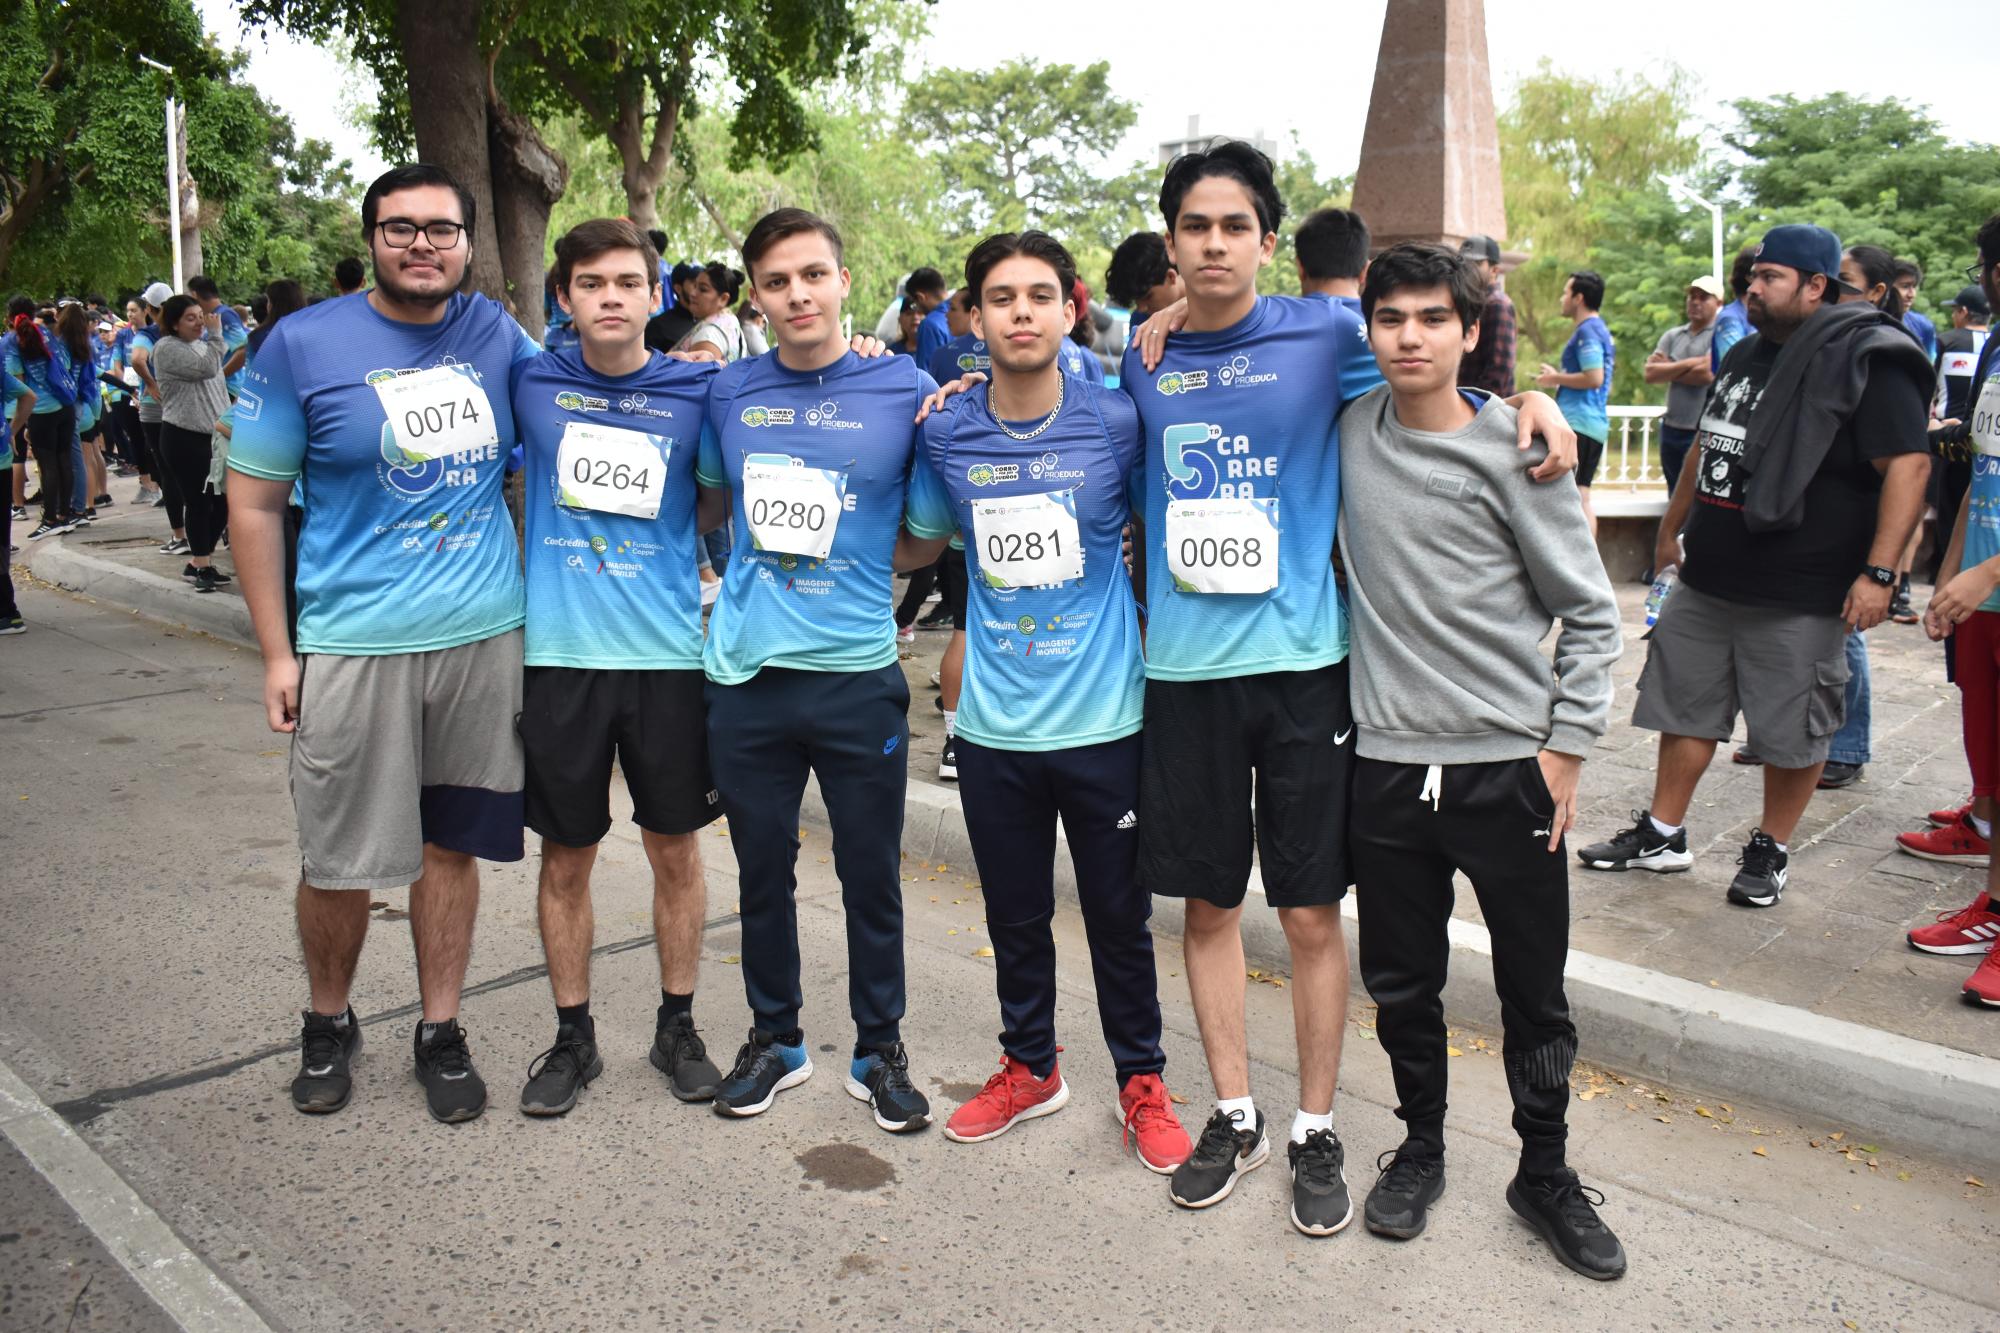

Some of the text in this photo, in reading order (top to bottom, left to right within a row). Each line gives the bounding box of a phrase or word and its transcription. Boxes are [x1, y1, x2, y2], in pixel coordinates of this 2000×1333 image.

[1235, 373, 1278, 385] PROEDUCA
[405, 398, 479, 438] 0074
[821, 420, 863, 429] PROEDUCA
[1216, 435, 1250, 456] CA
[446, 467, 478, 488] RA
[573, 457, 649, 494] 0264
[995, 465, 1018, 473] CORRO
[1044, 470, 1085, 479] PROEDUCA
[1227, 456, 1278, 479] RRE
[752, 498, 825, 532] 0280
[988, 529, 1061, 562] 0281
[1180, 537, 1262, 567] 0068
